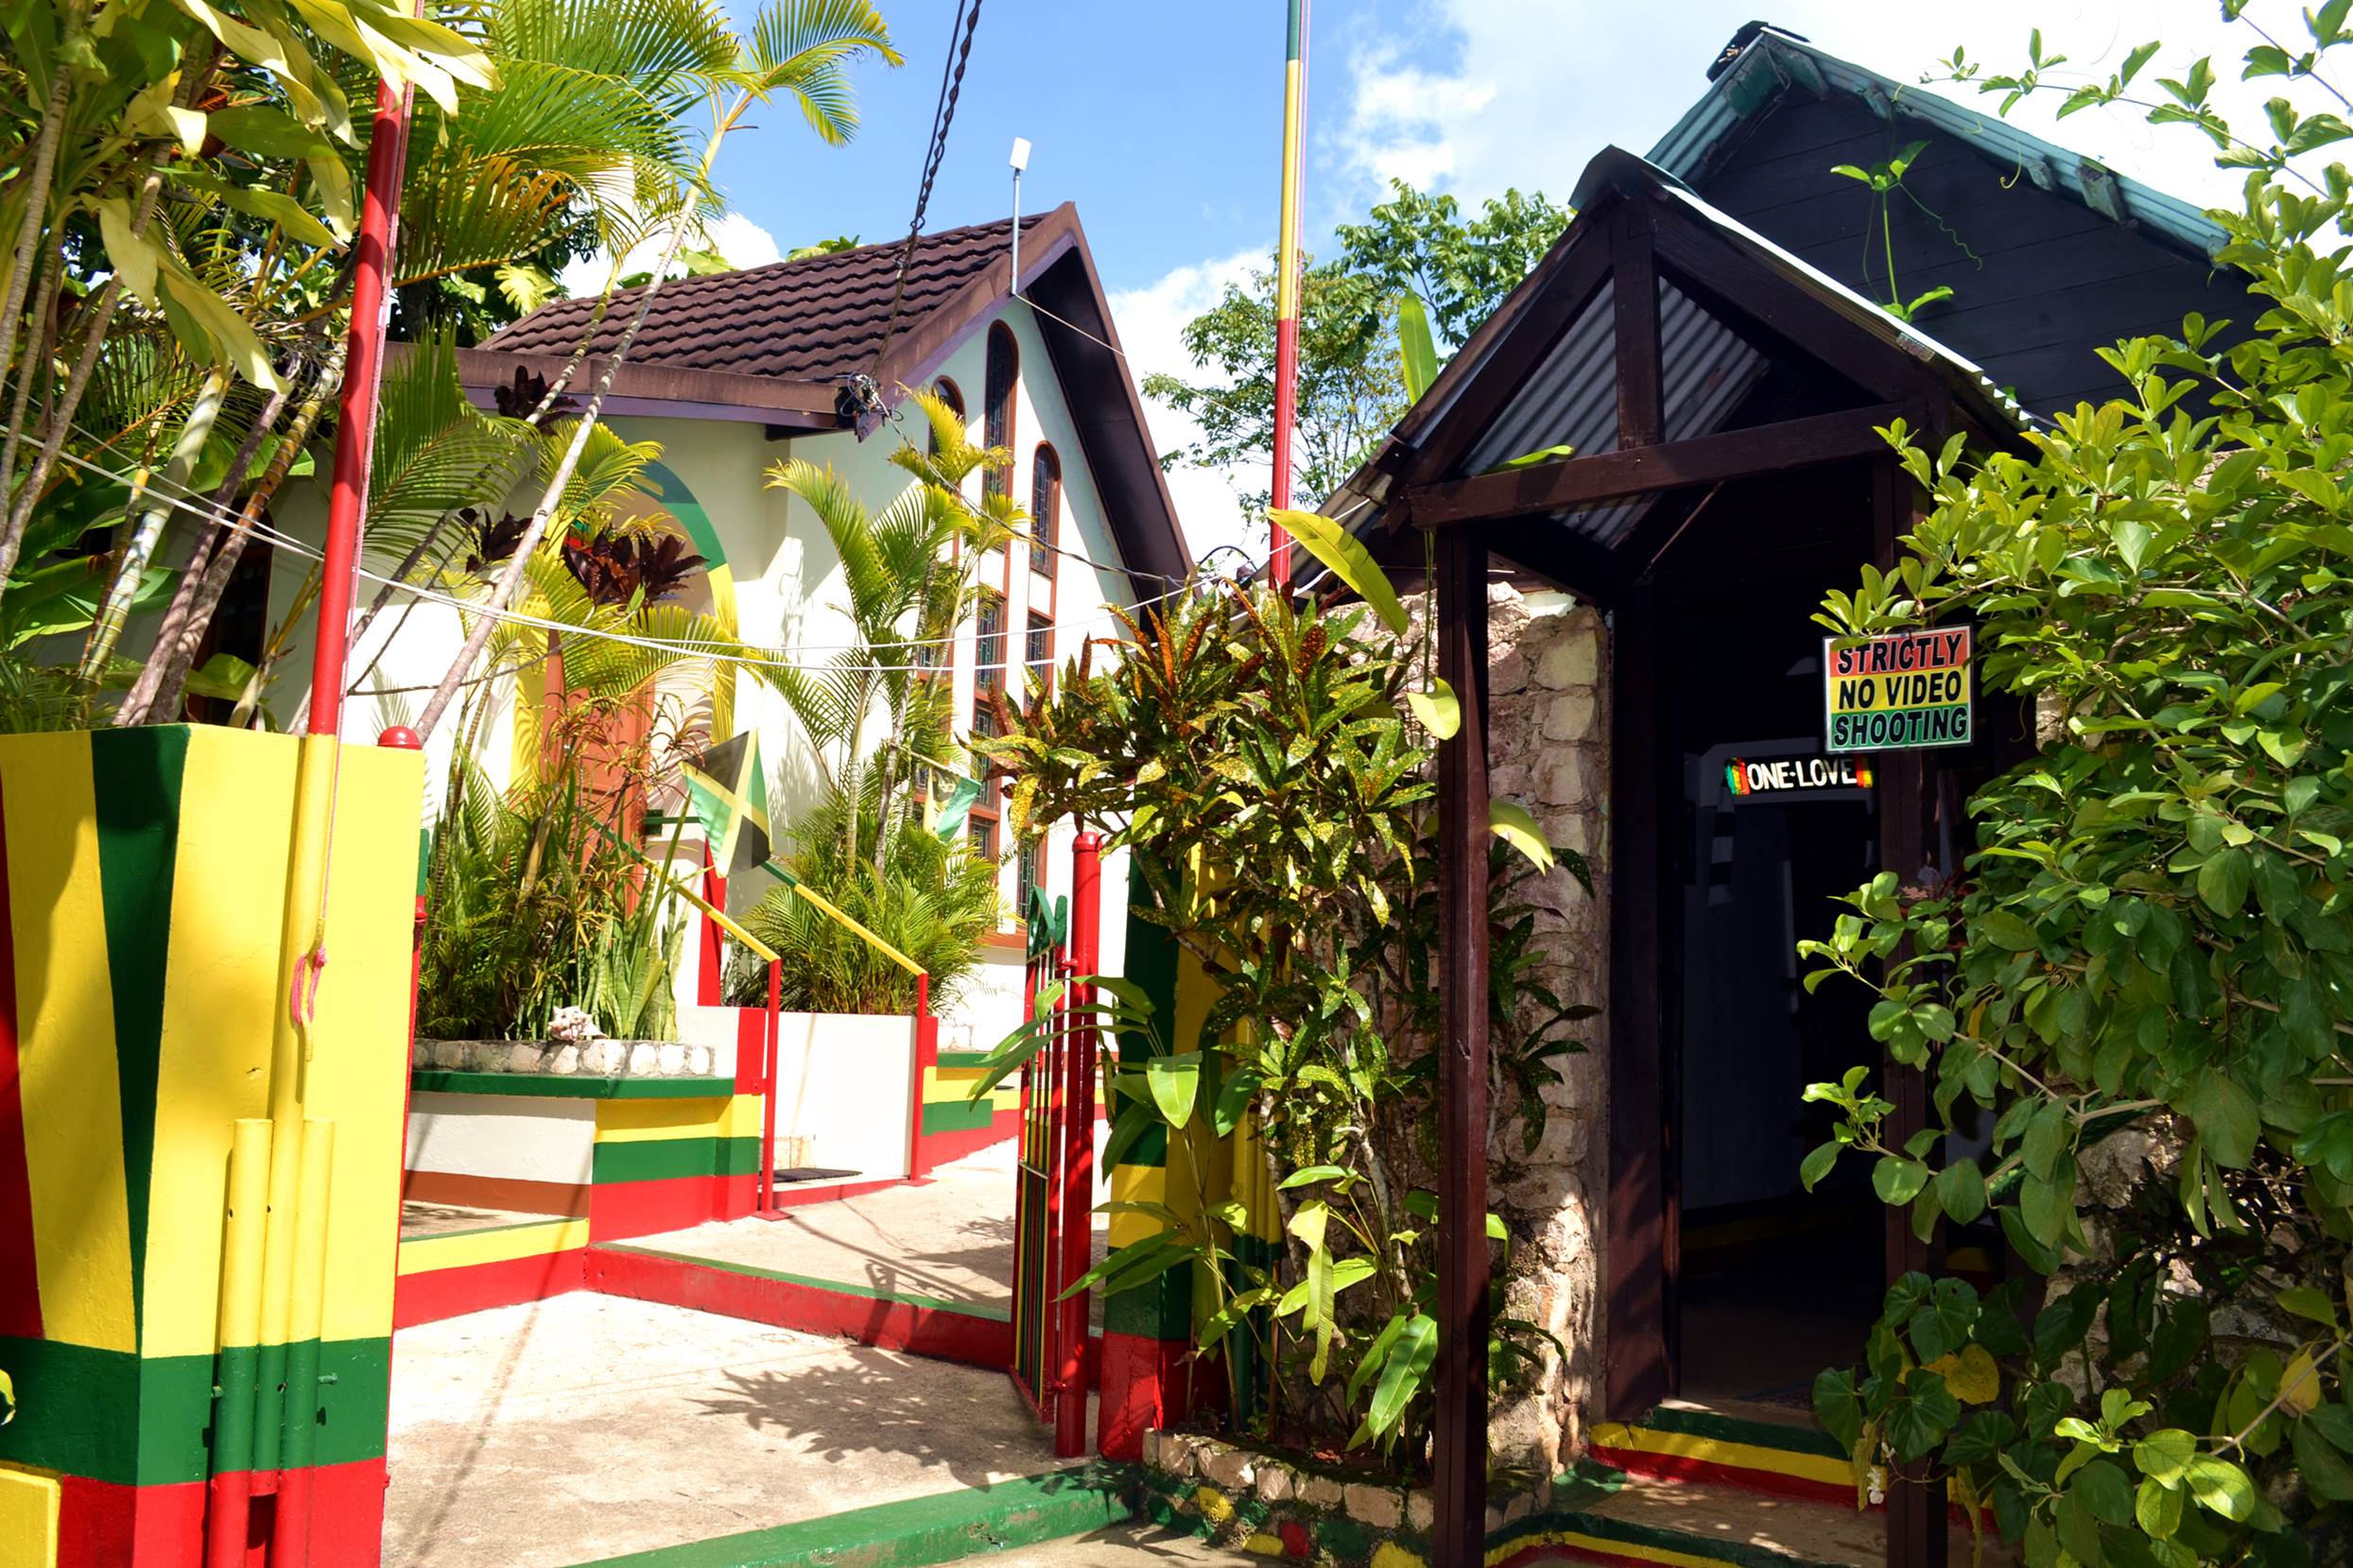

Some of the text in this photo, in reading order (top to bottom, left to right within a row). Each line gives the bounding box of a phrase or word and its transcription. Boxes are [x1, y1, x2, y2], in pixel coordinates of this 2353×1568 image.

[1837, 633, 1963, 674] STRICTLY
[1839, 670, 1962, 710] NO VIDEO
[1834, 707, 1967, 746] SHOOTING
